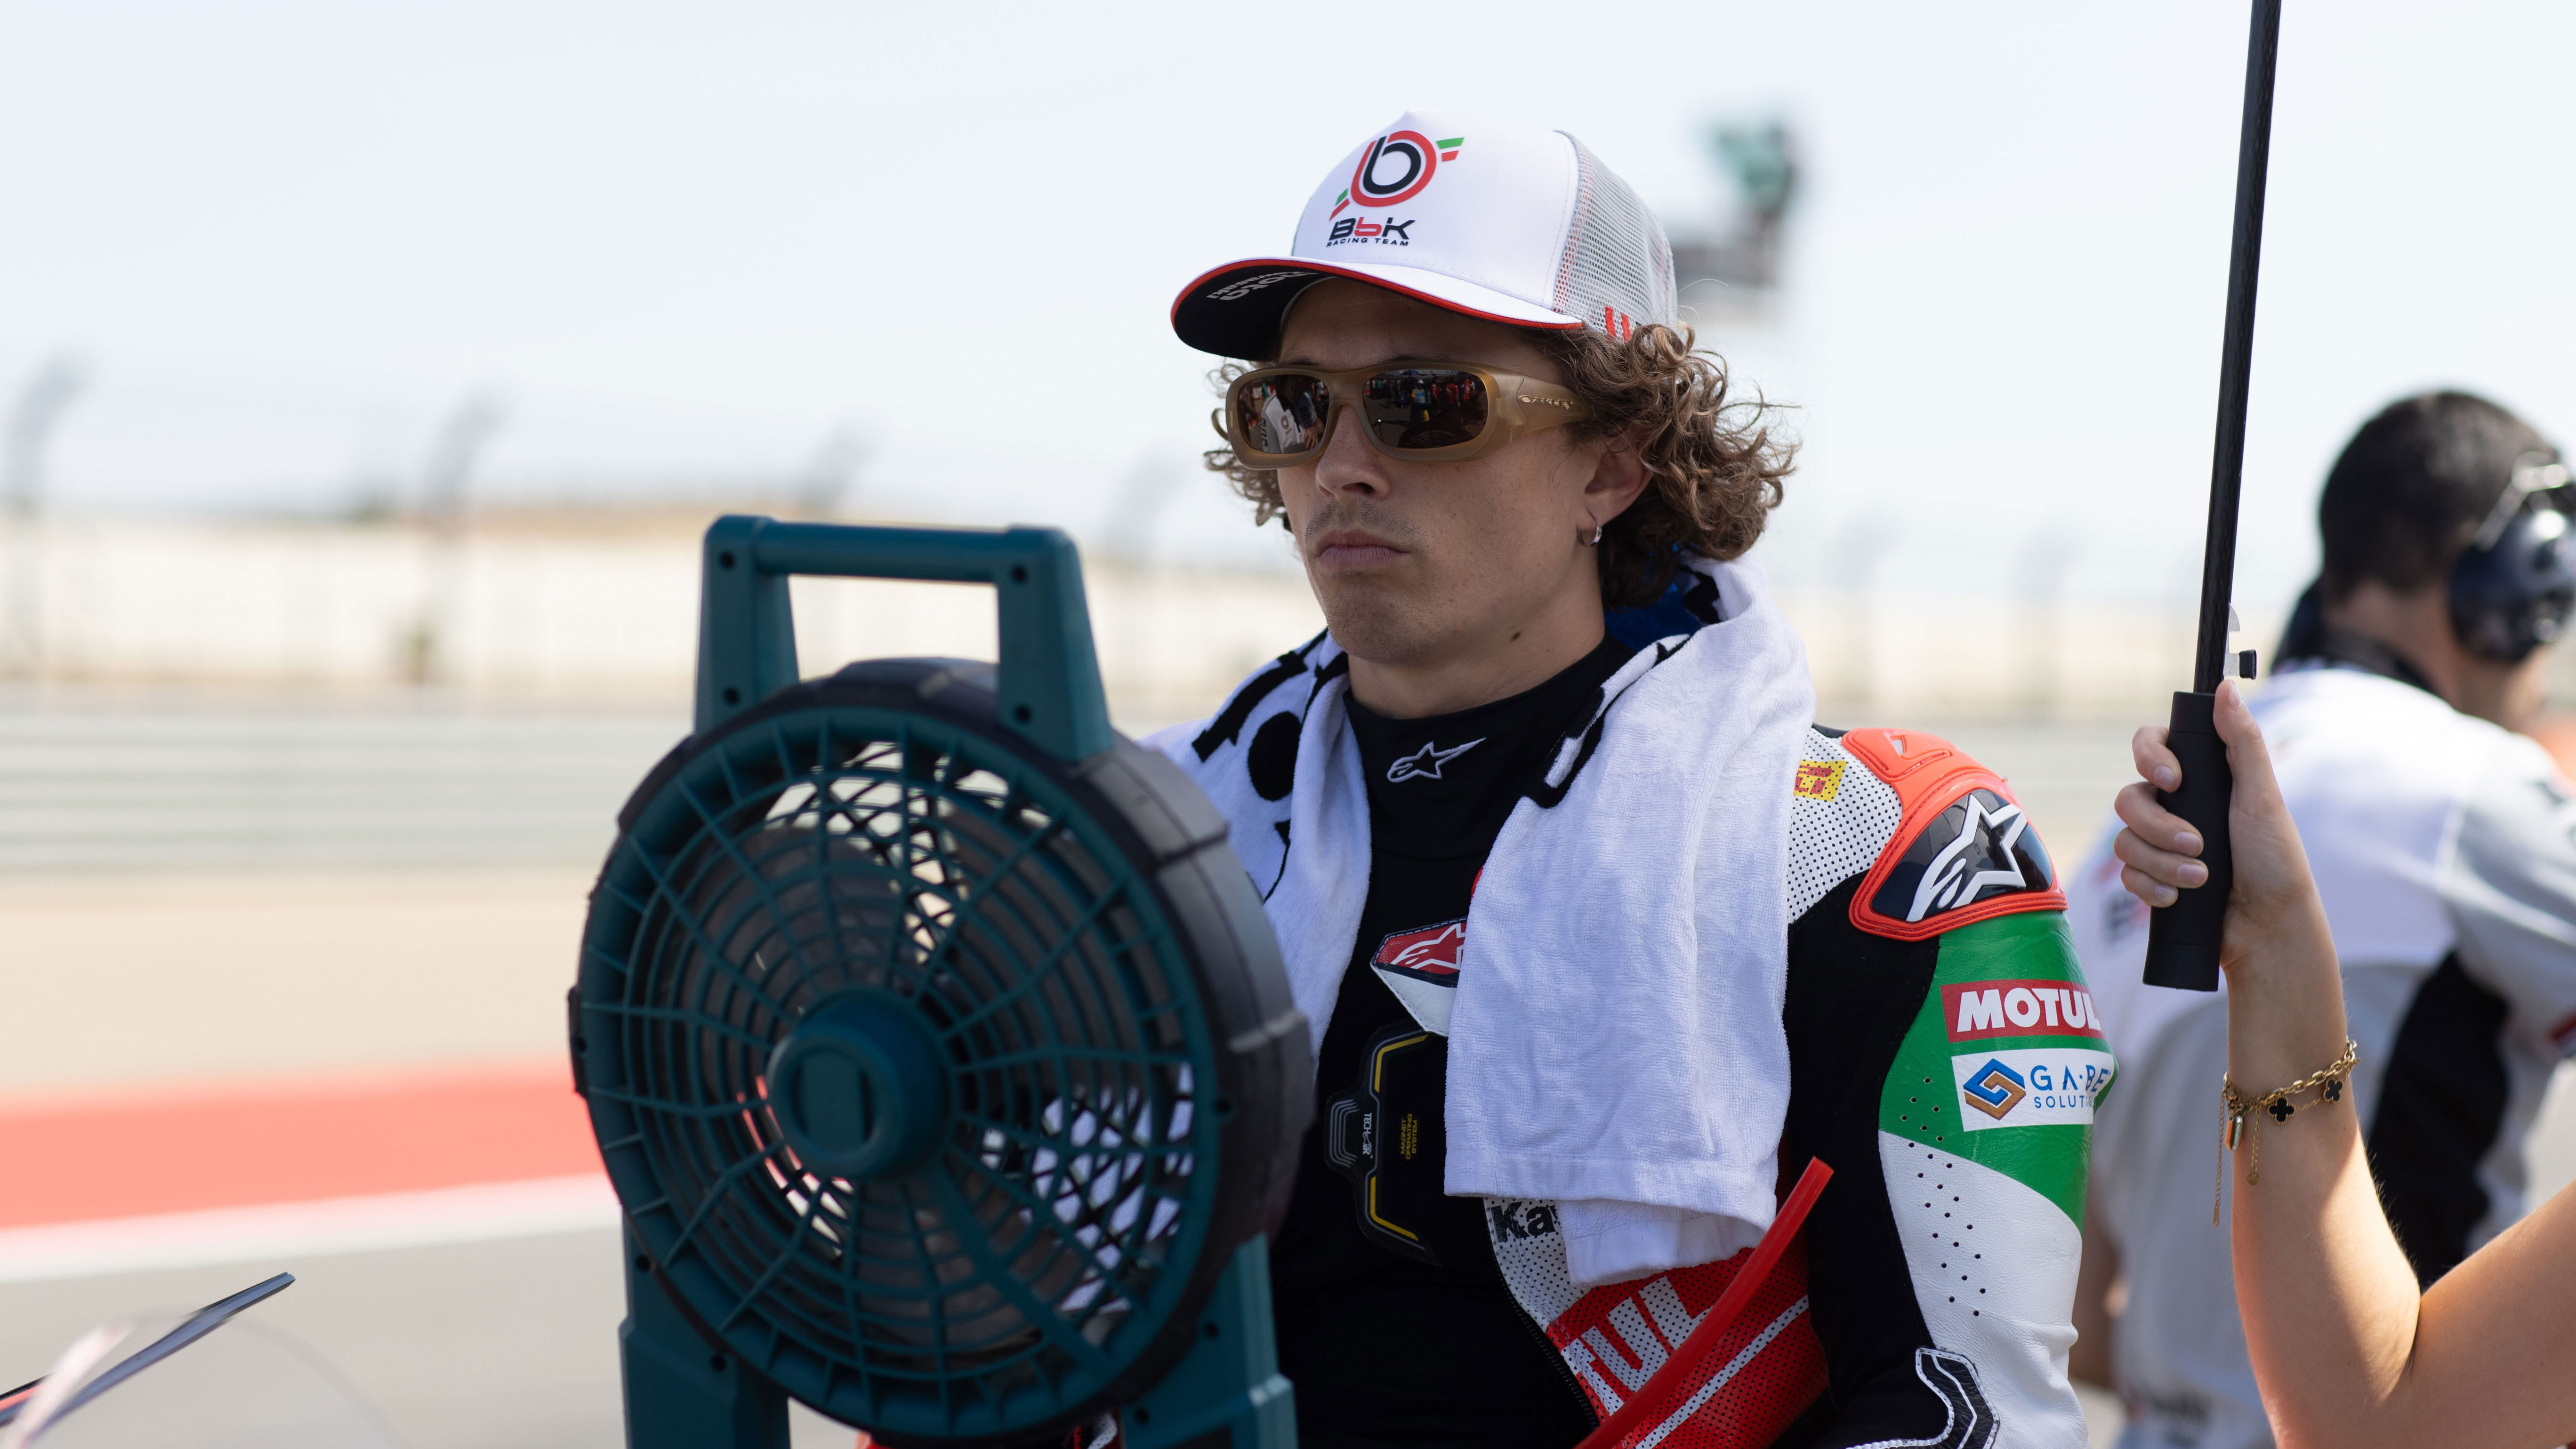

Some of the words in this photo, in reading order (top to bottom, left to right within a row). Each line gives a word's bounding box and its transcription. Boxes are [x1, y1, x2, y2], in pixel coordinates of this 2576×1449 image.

[1327, 238, 1368, 247] RACING
[1375, 238, 1409, 246] TEAM
[1518, 395, 1574, 410] OAKLEY
[1957, 988, 2101, 1032] MOTUL
